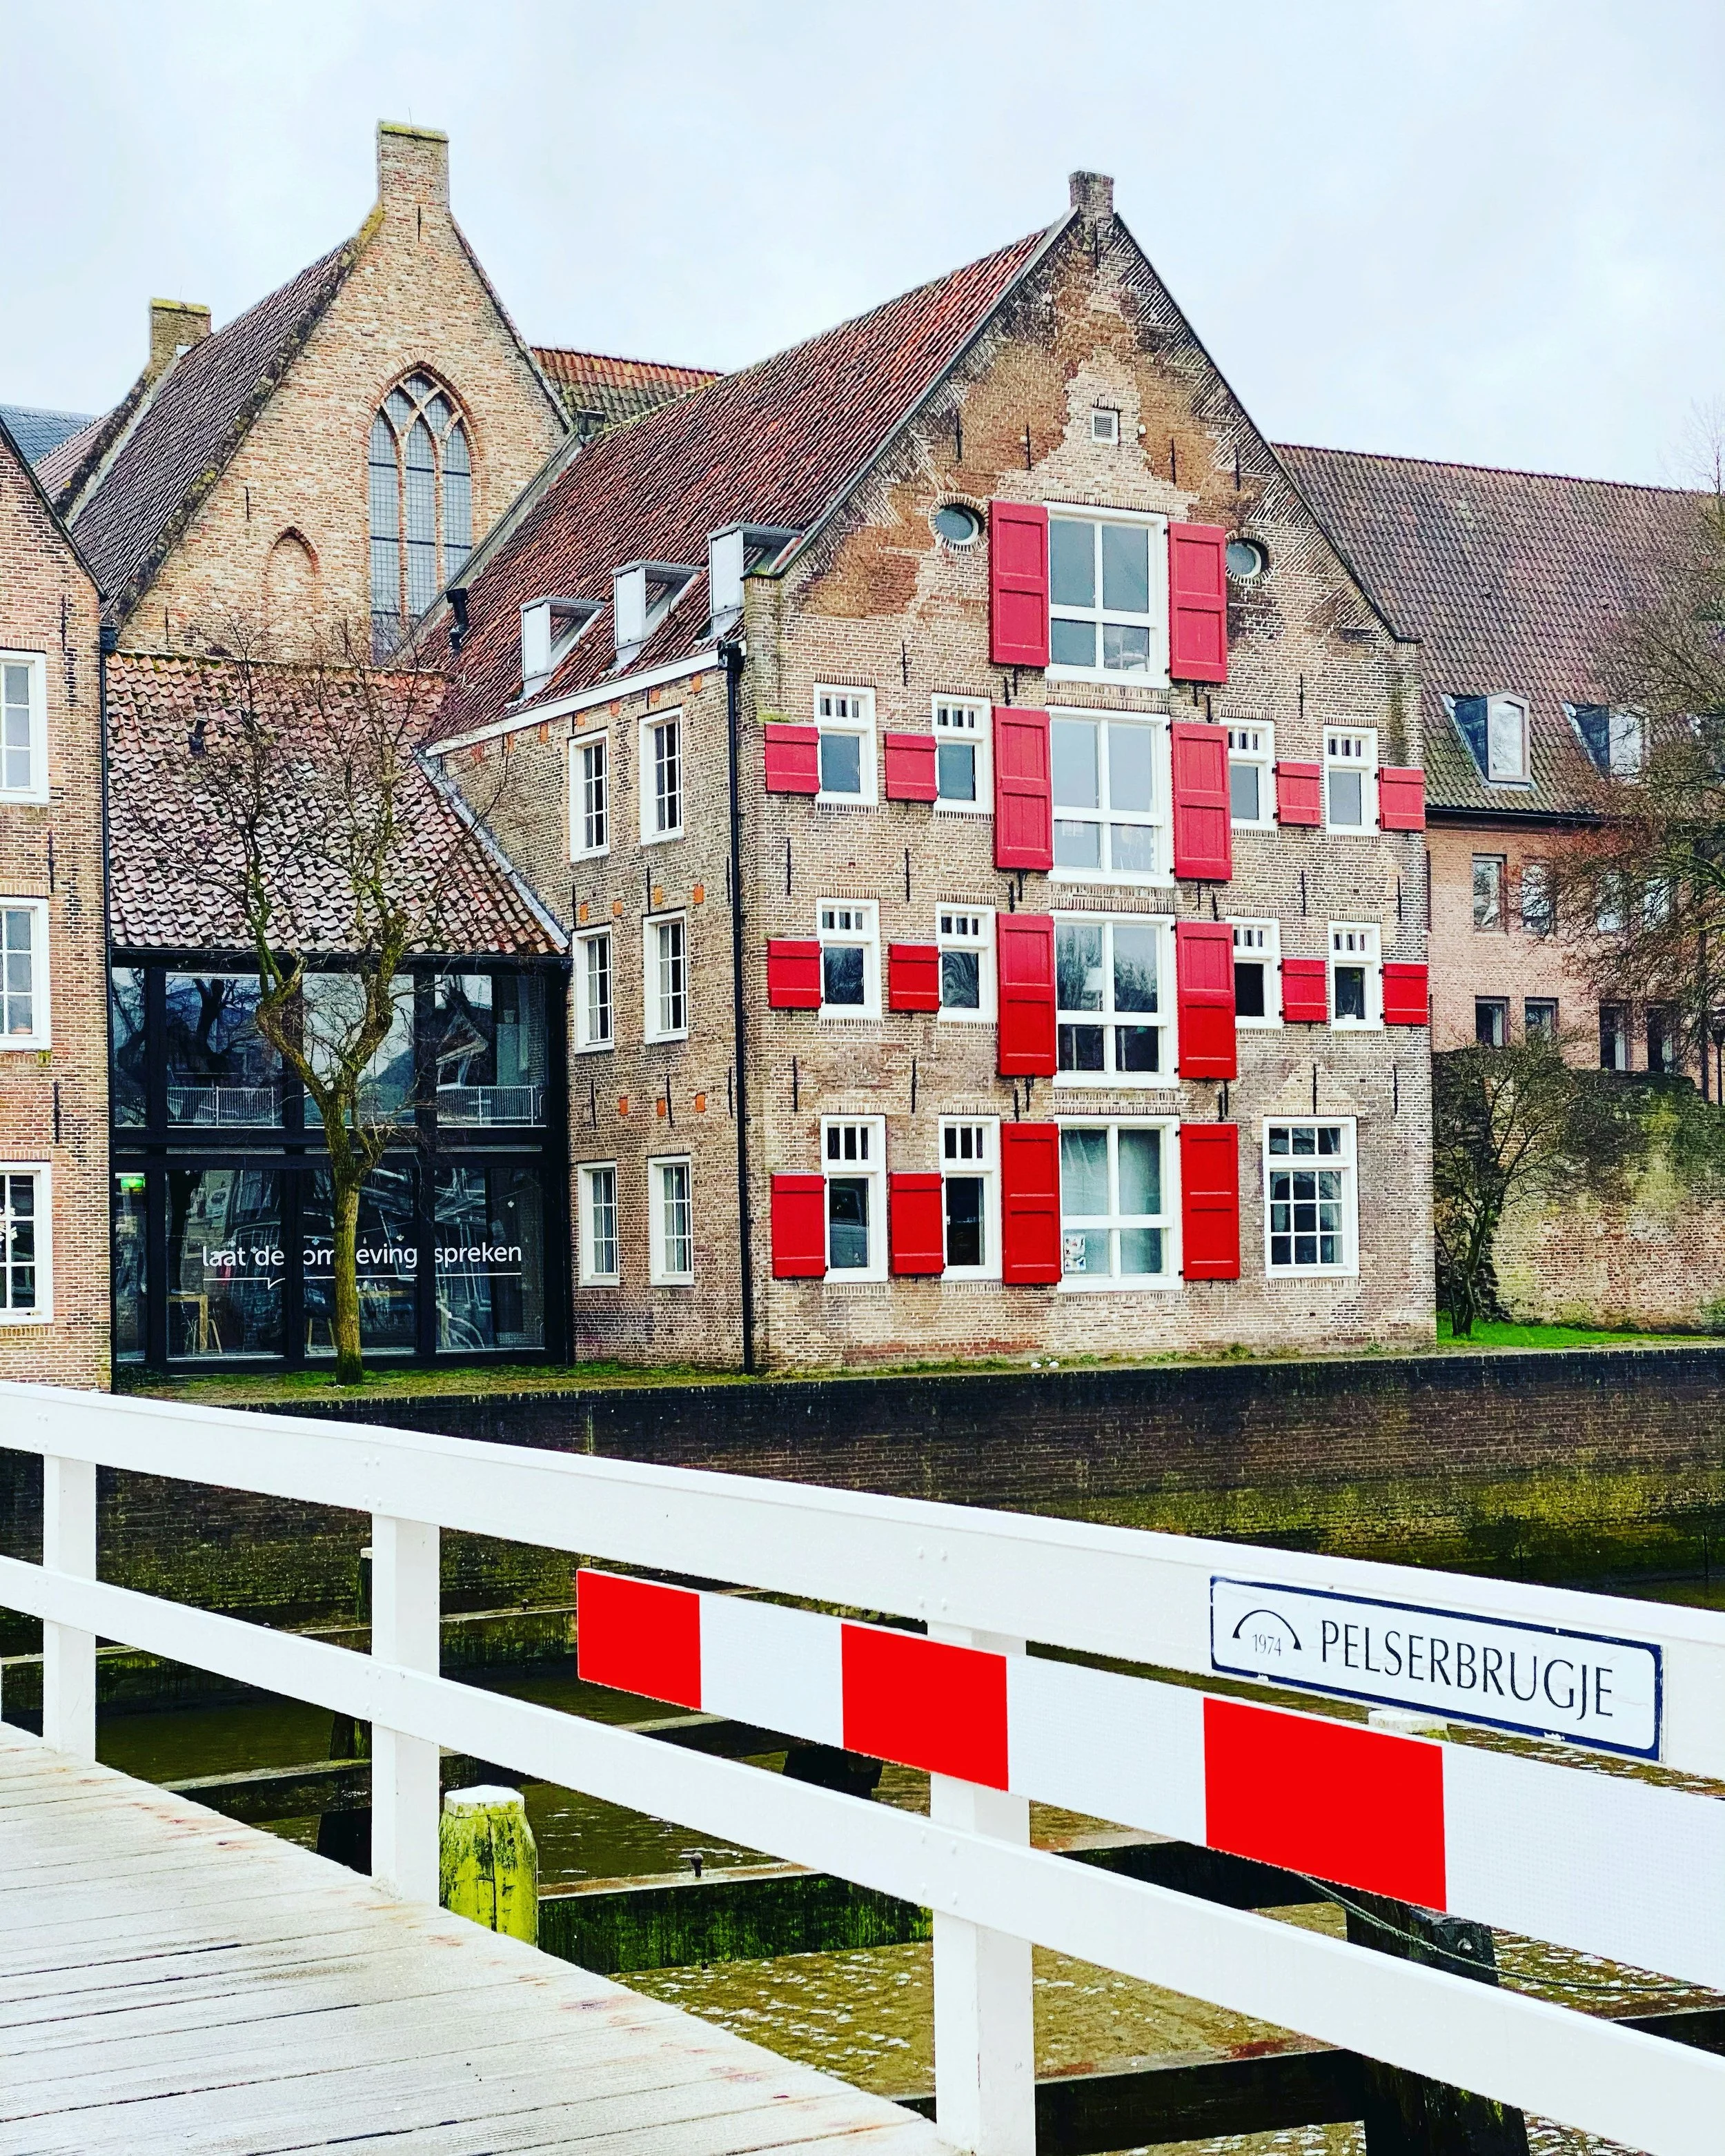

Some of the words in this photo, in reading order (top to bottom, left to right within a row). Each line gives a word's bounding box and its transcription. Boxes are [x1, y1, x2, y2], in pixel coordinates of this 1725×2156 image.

[203, 1245, 246, 1267] laat
[255, 1245, 285, 1266] de
[303, 1243, 417, 1269] omeving
[434, 1242, 522, 1268] spreken
[1252, 1634, 1281, 1656] 1974
[1321, 1619, 1614, 1720] PELSERBRUGJE
